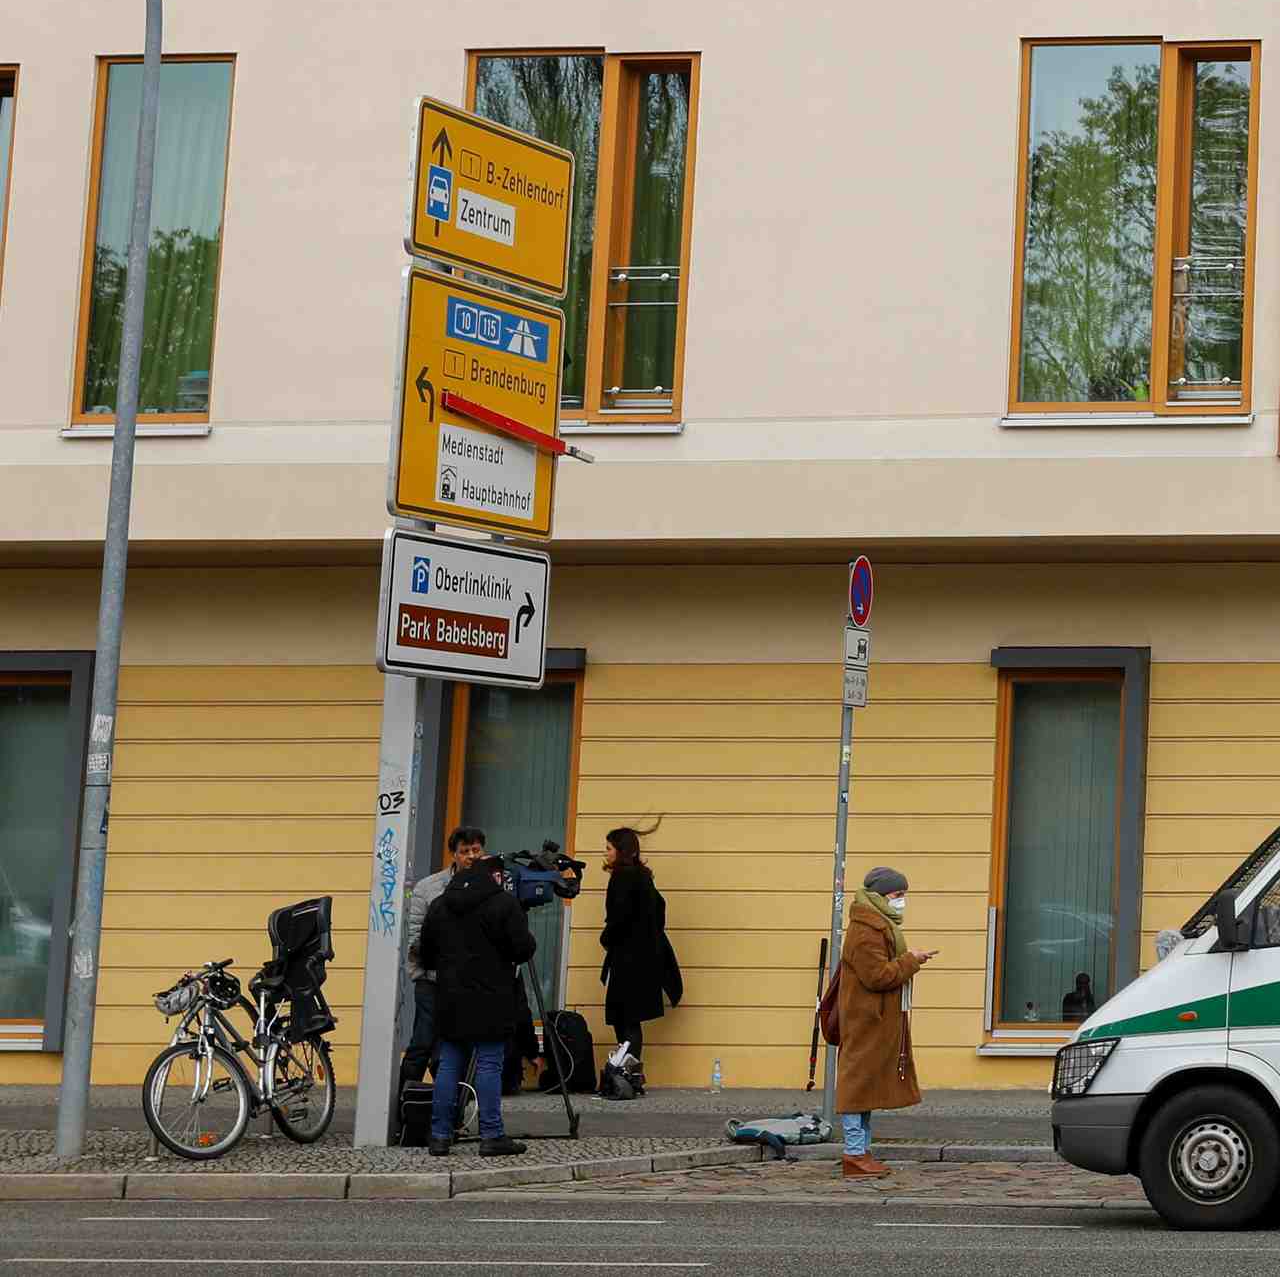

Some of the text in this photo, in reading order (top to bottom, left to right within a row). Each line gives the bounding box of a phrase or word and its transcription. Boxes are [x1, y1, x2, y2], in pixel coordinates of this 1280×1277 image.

[486, 161, 565, 210] B.-Zehlendorf
[460, 198, 512, 237] Zentrum
[461, 312, 497, 338] 10 115
[470, 358, 547, 404] Brandenburg
[442, 433, 504, 465] Medienstadt
[461, 478, 531, 511] Hauptbahnhof
[435, 566, 512, 601] Oberlinklinik
[400, 613, 506, 657] Park Babelsberg
